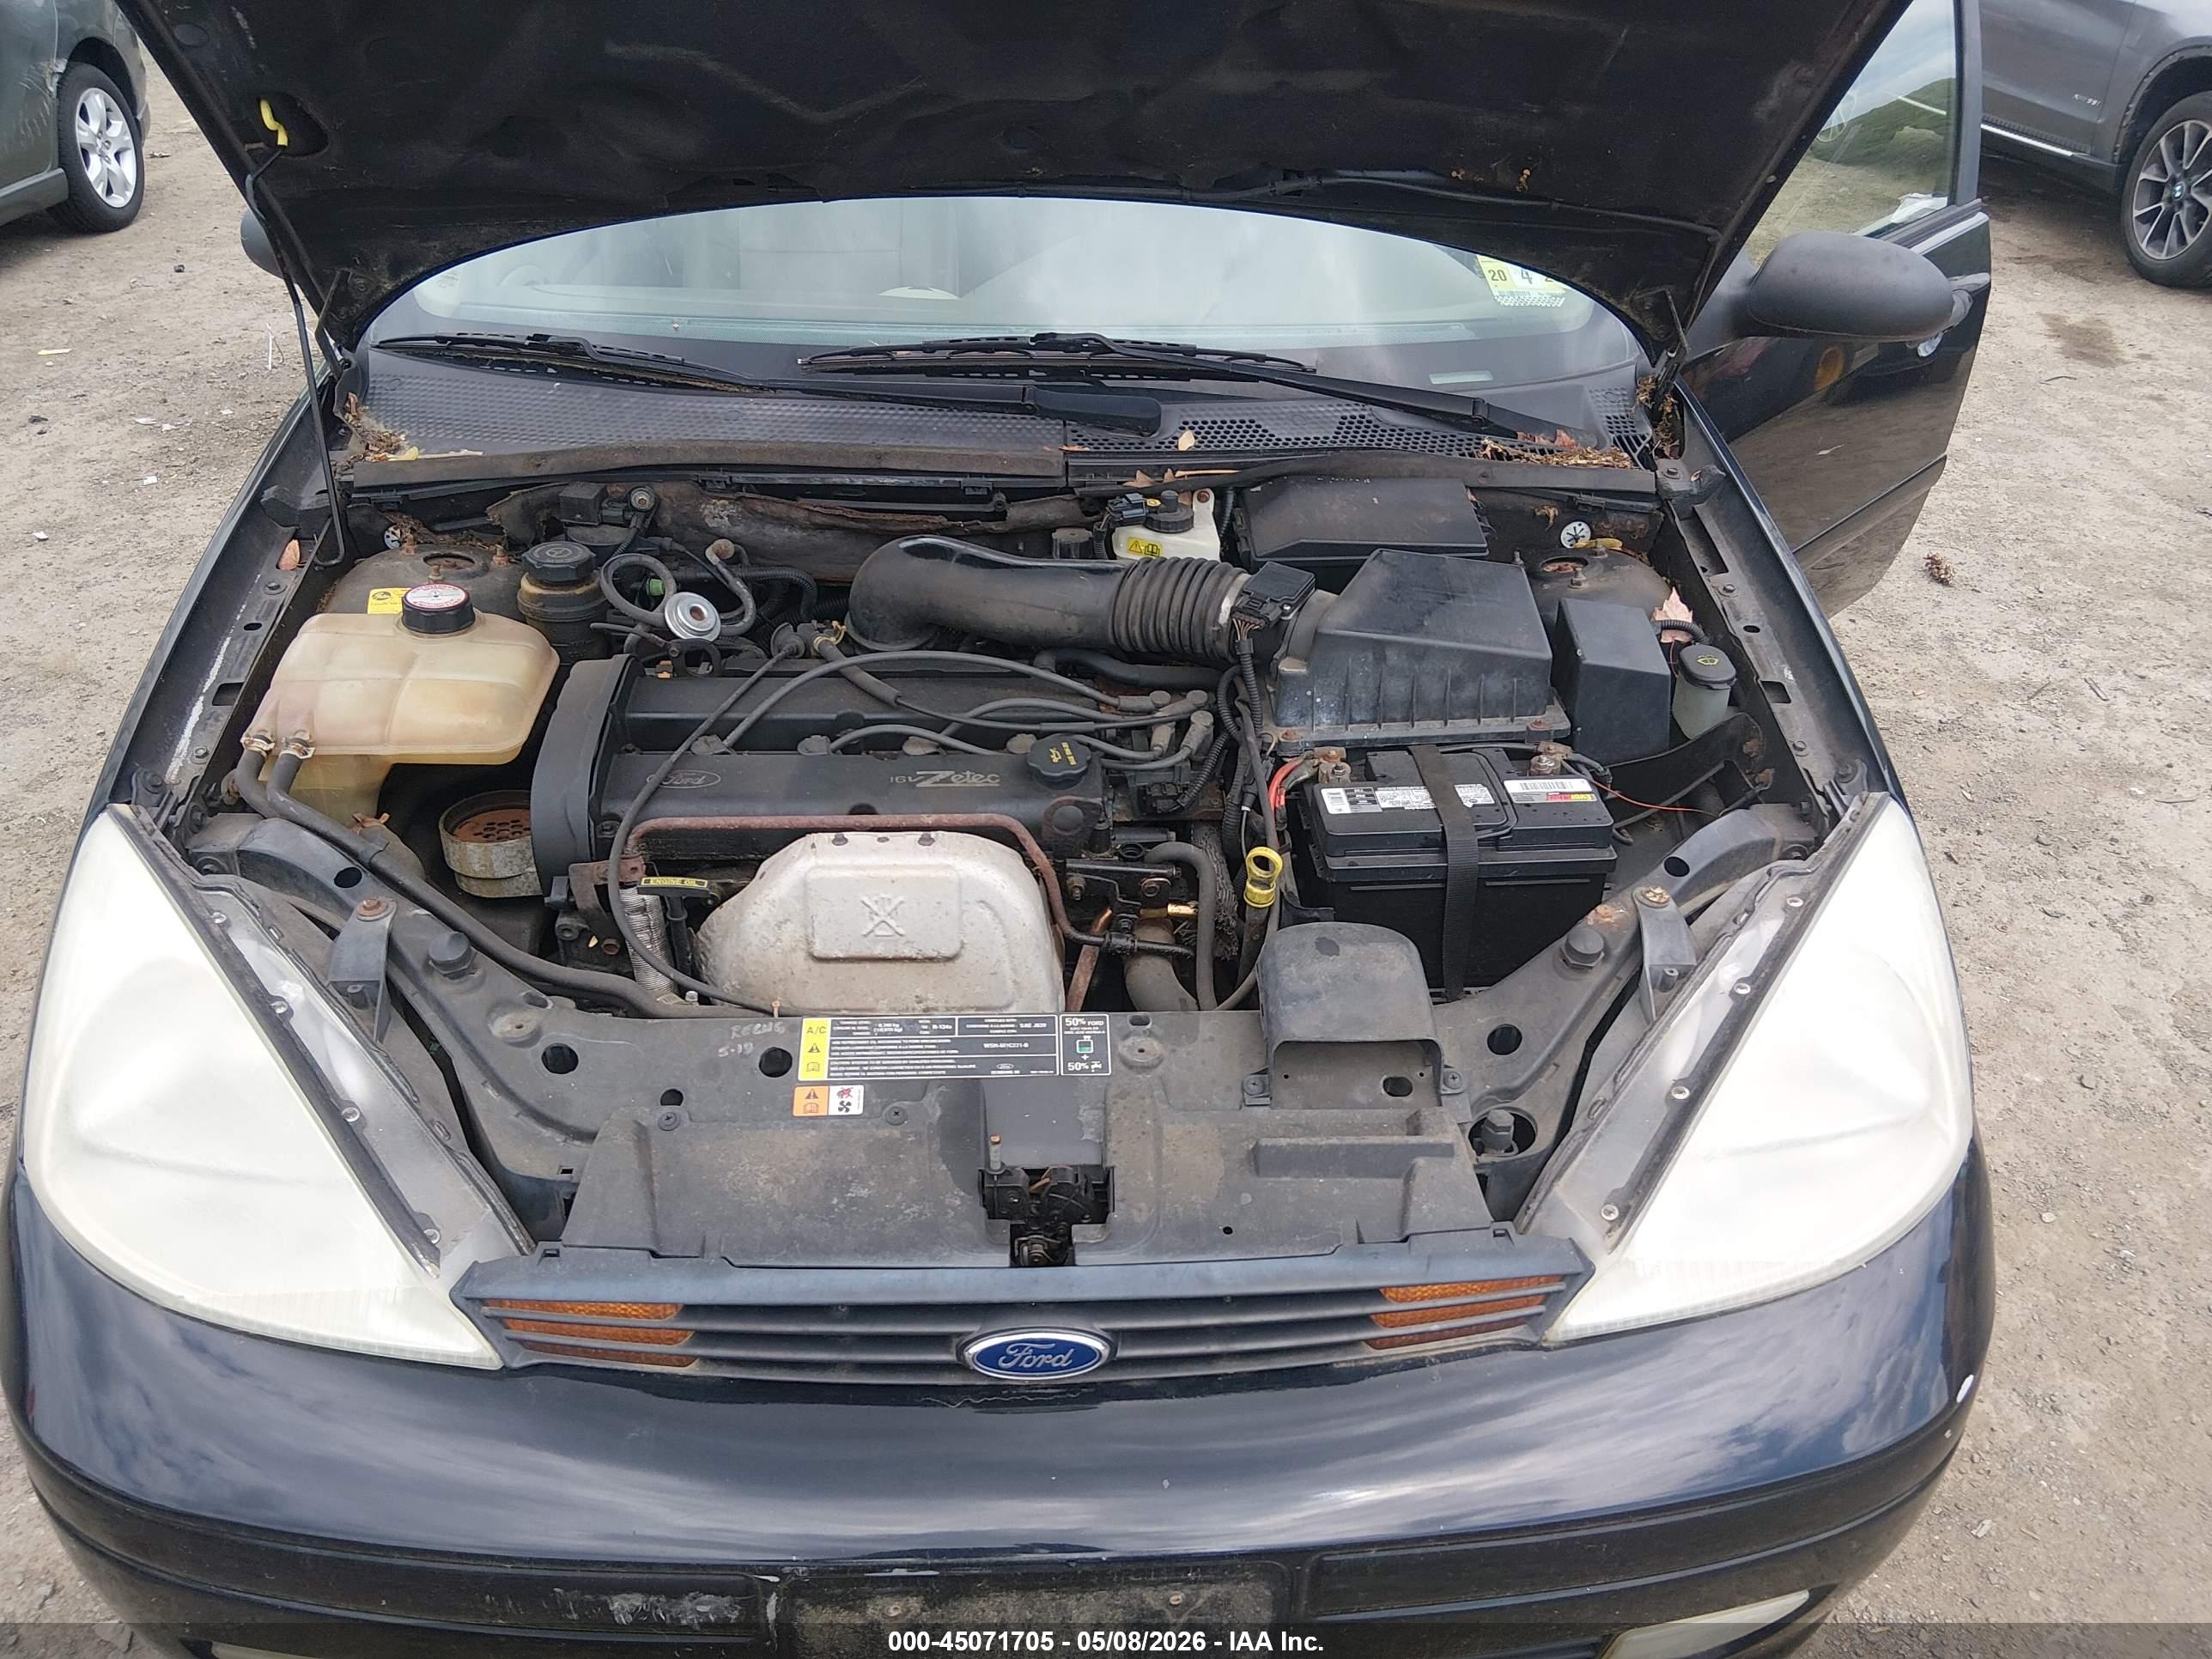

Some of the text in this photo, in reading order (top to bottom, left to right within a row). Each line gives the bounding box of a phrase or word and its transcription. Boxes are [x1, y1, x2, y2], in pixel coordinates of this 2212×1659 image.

[1488, 269, 1507, 282] 20
[915, 770, 1000, 787] Zetec
[1064, 1017, 1087, 1027] 50%
[805, 1025, 827, 1036] A/C
[1066, 1061, 1090, 1072] 50%
[997, 1342, 1075, 1370] Ford
